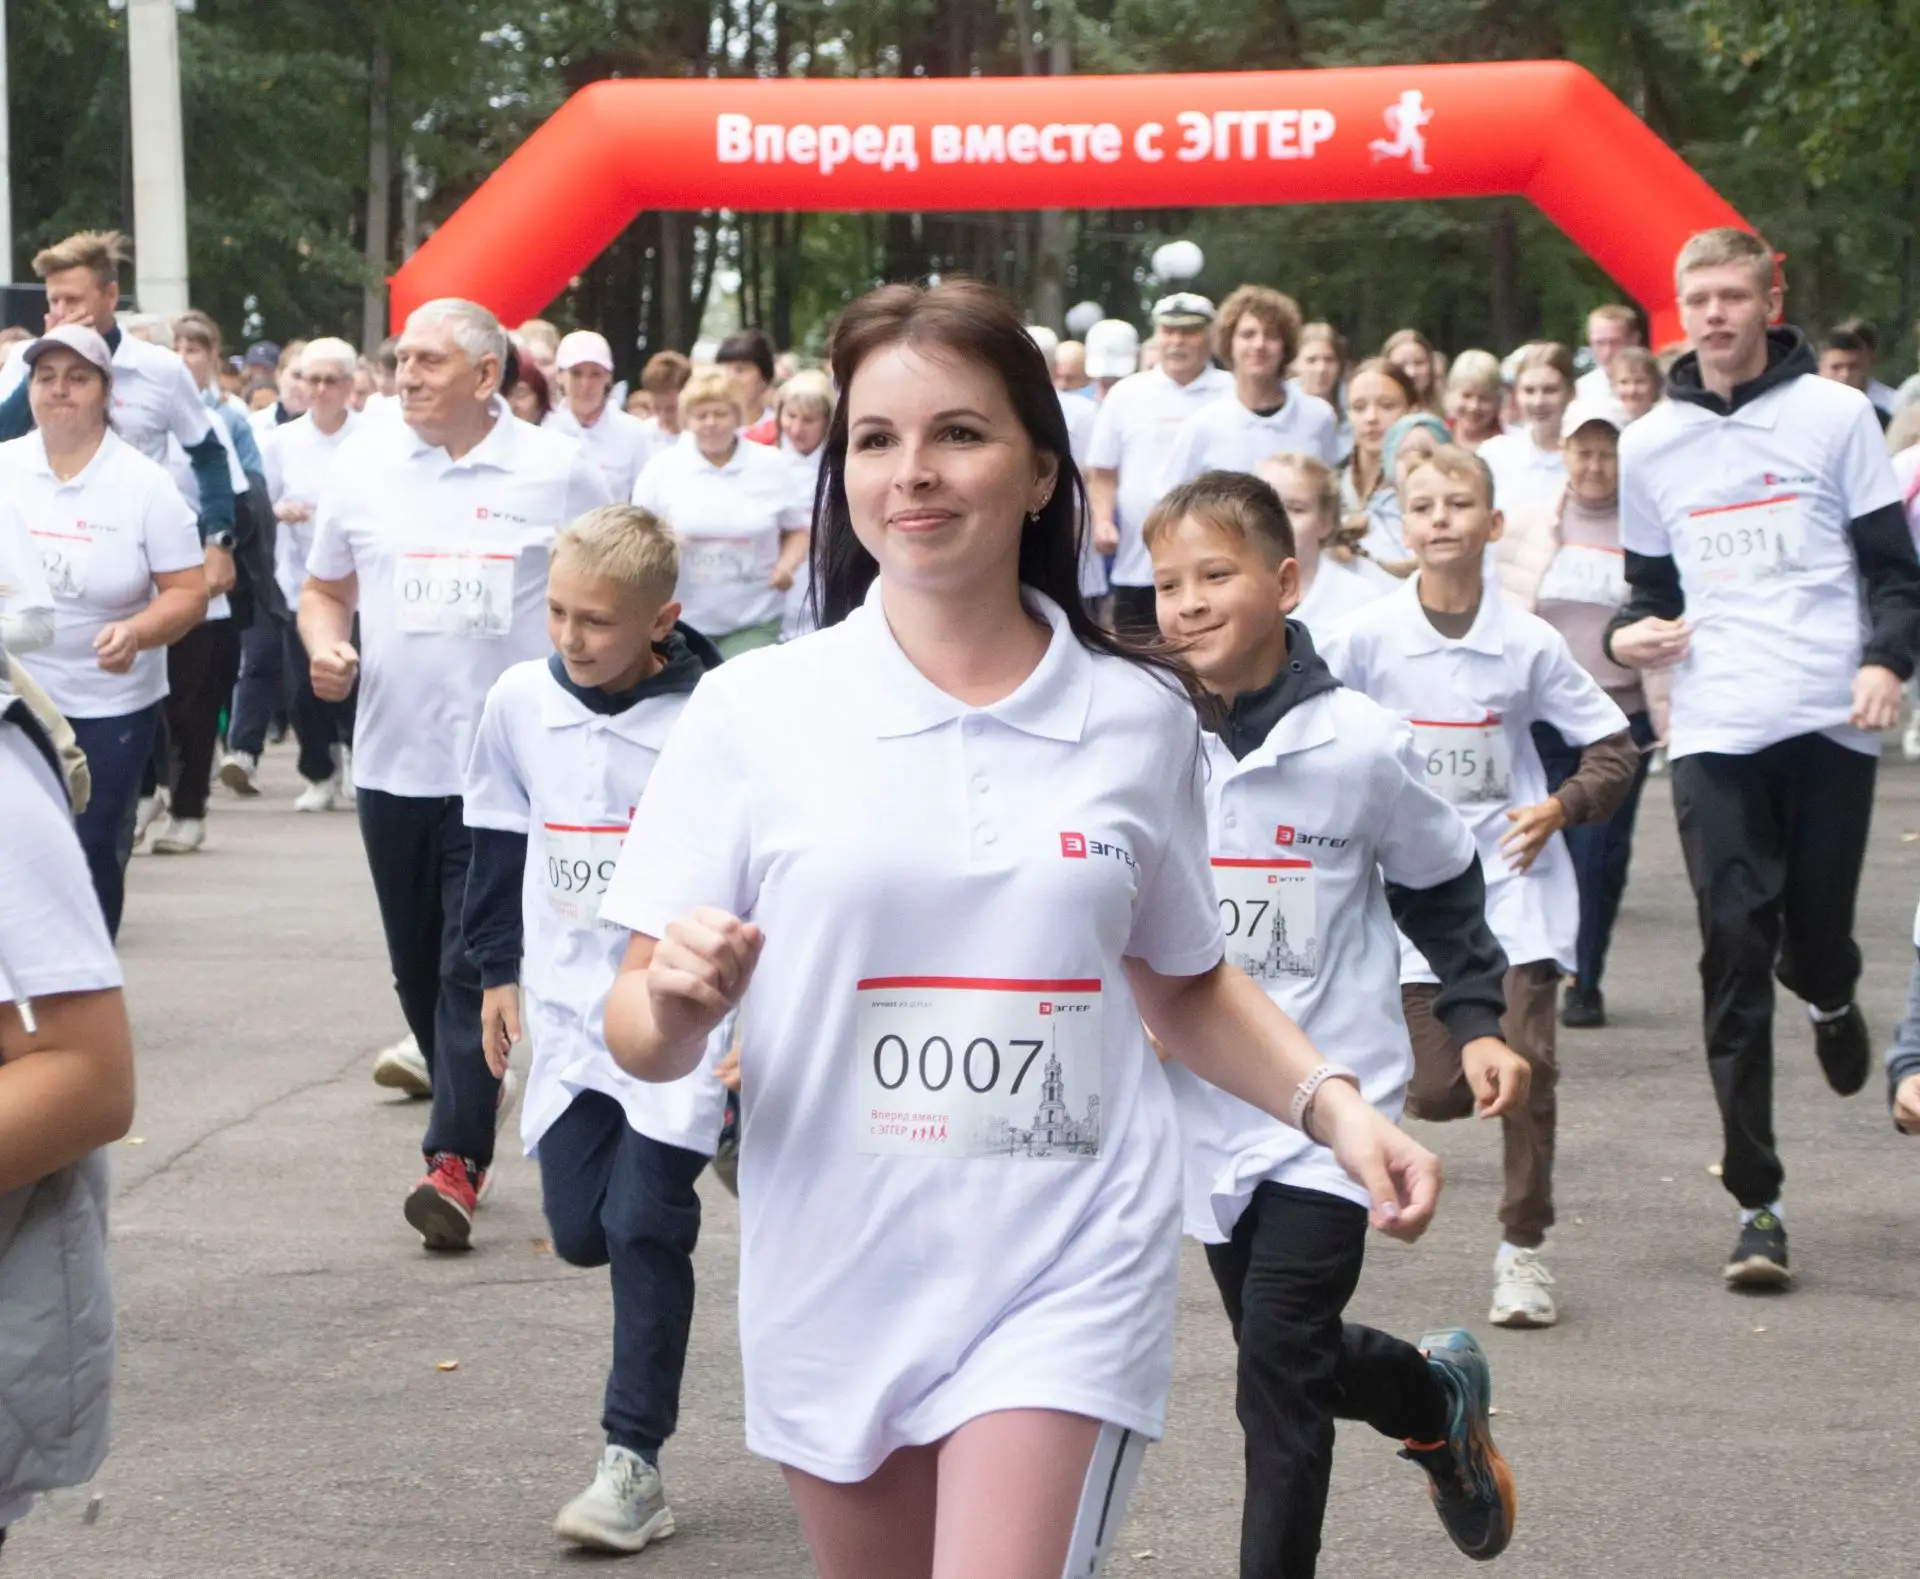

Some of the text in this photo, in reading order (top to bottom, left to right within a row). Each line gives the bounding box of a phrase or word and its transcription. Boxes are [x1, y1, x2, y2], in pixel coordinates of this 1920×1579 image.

[716, 113, 918, 175] Вперед
[931, 123, 1122, 163] вместе
[1176, 109, 1336, 162] ЭГГЕР
[1699, 528, 1766, 561] 2031
[404, 569, 483, 603] 0039
[1426, 749, 1476, 777] 615
[874, 1034, 1044, 1096] 0007
[871, 1109, 909, 1122] Вперед
